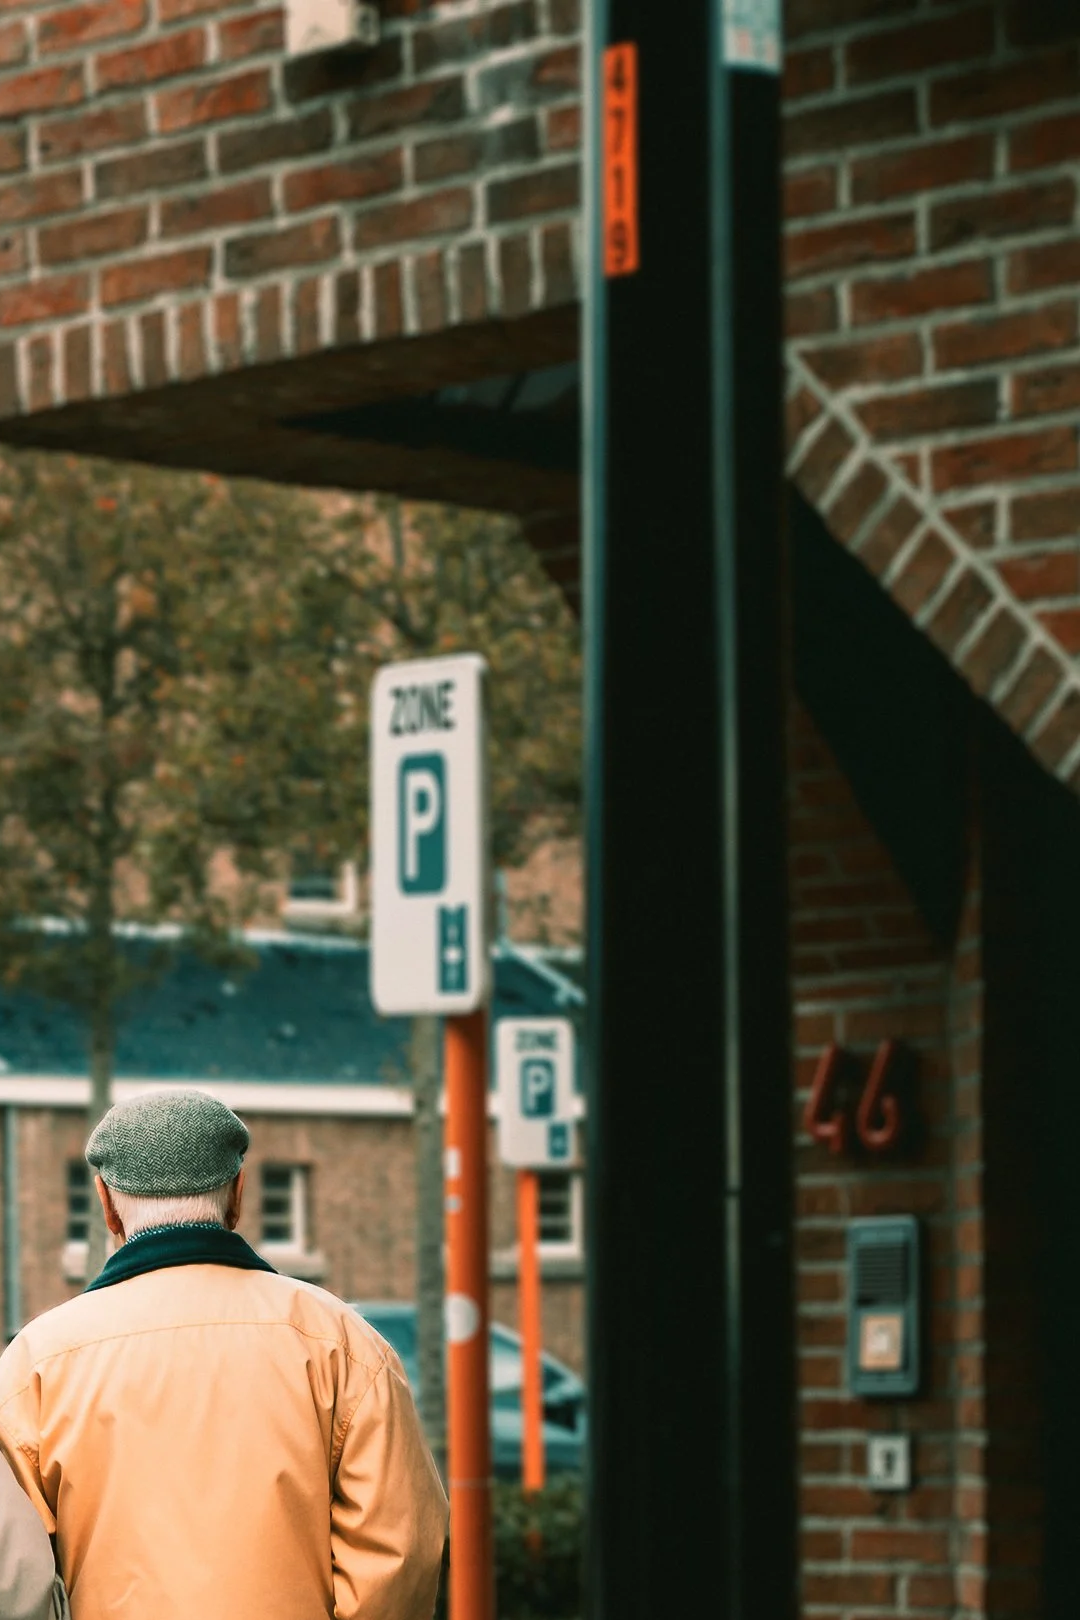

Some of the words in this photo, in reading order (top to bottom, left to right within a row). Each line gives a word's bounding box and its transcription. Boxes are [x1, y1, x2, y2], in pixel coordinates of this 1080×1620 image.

[390, 679, 455, 737] ZONE
[404, 768, 440, 881] P
[527, 1064, 549, 1112] P
[804, 1040, 898, 1151] 46
